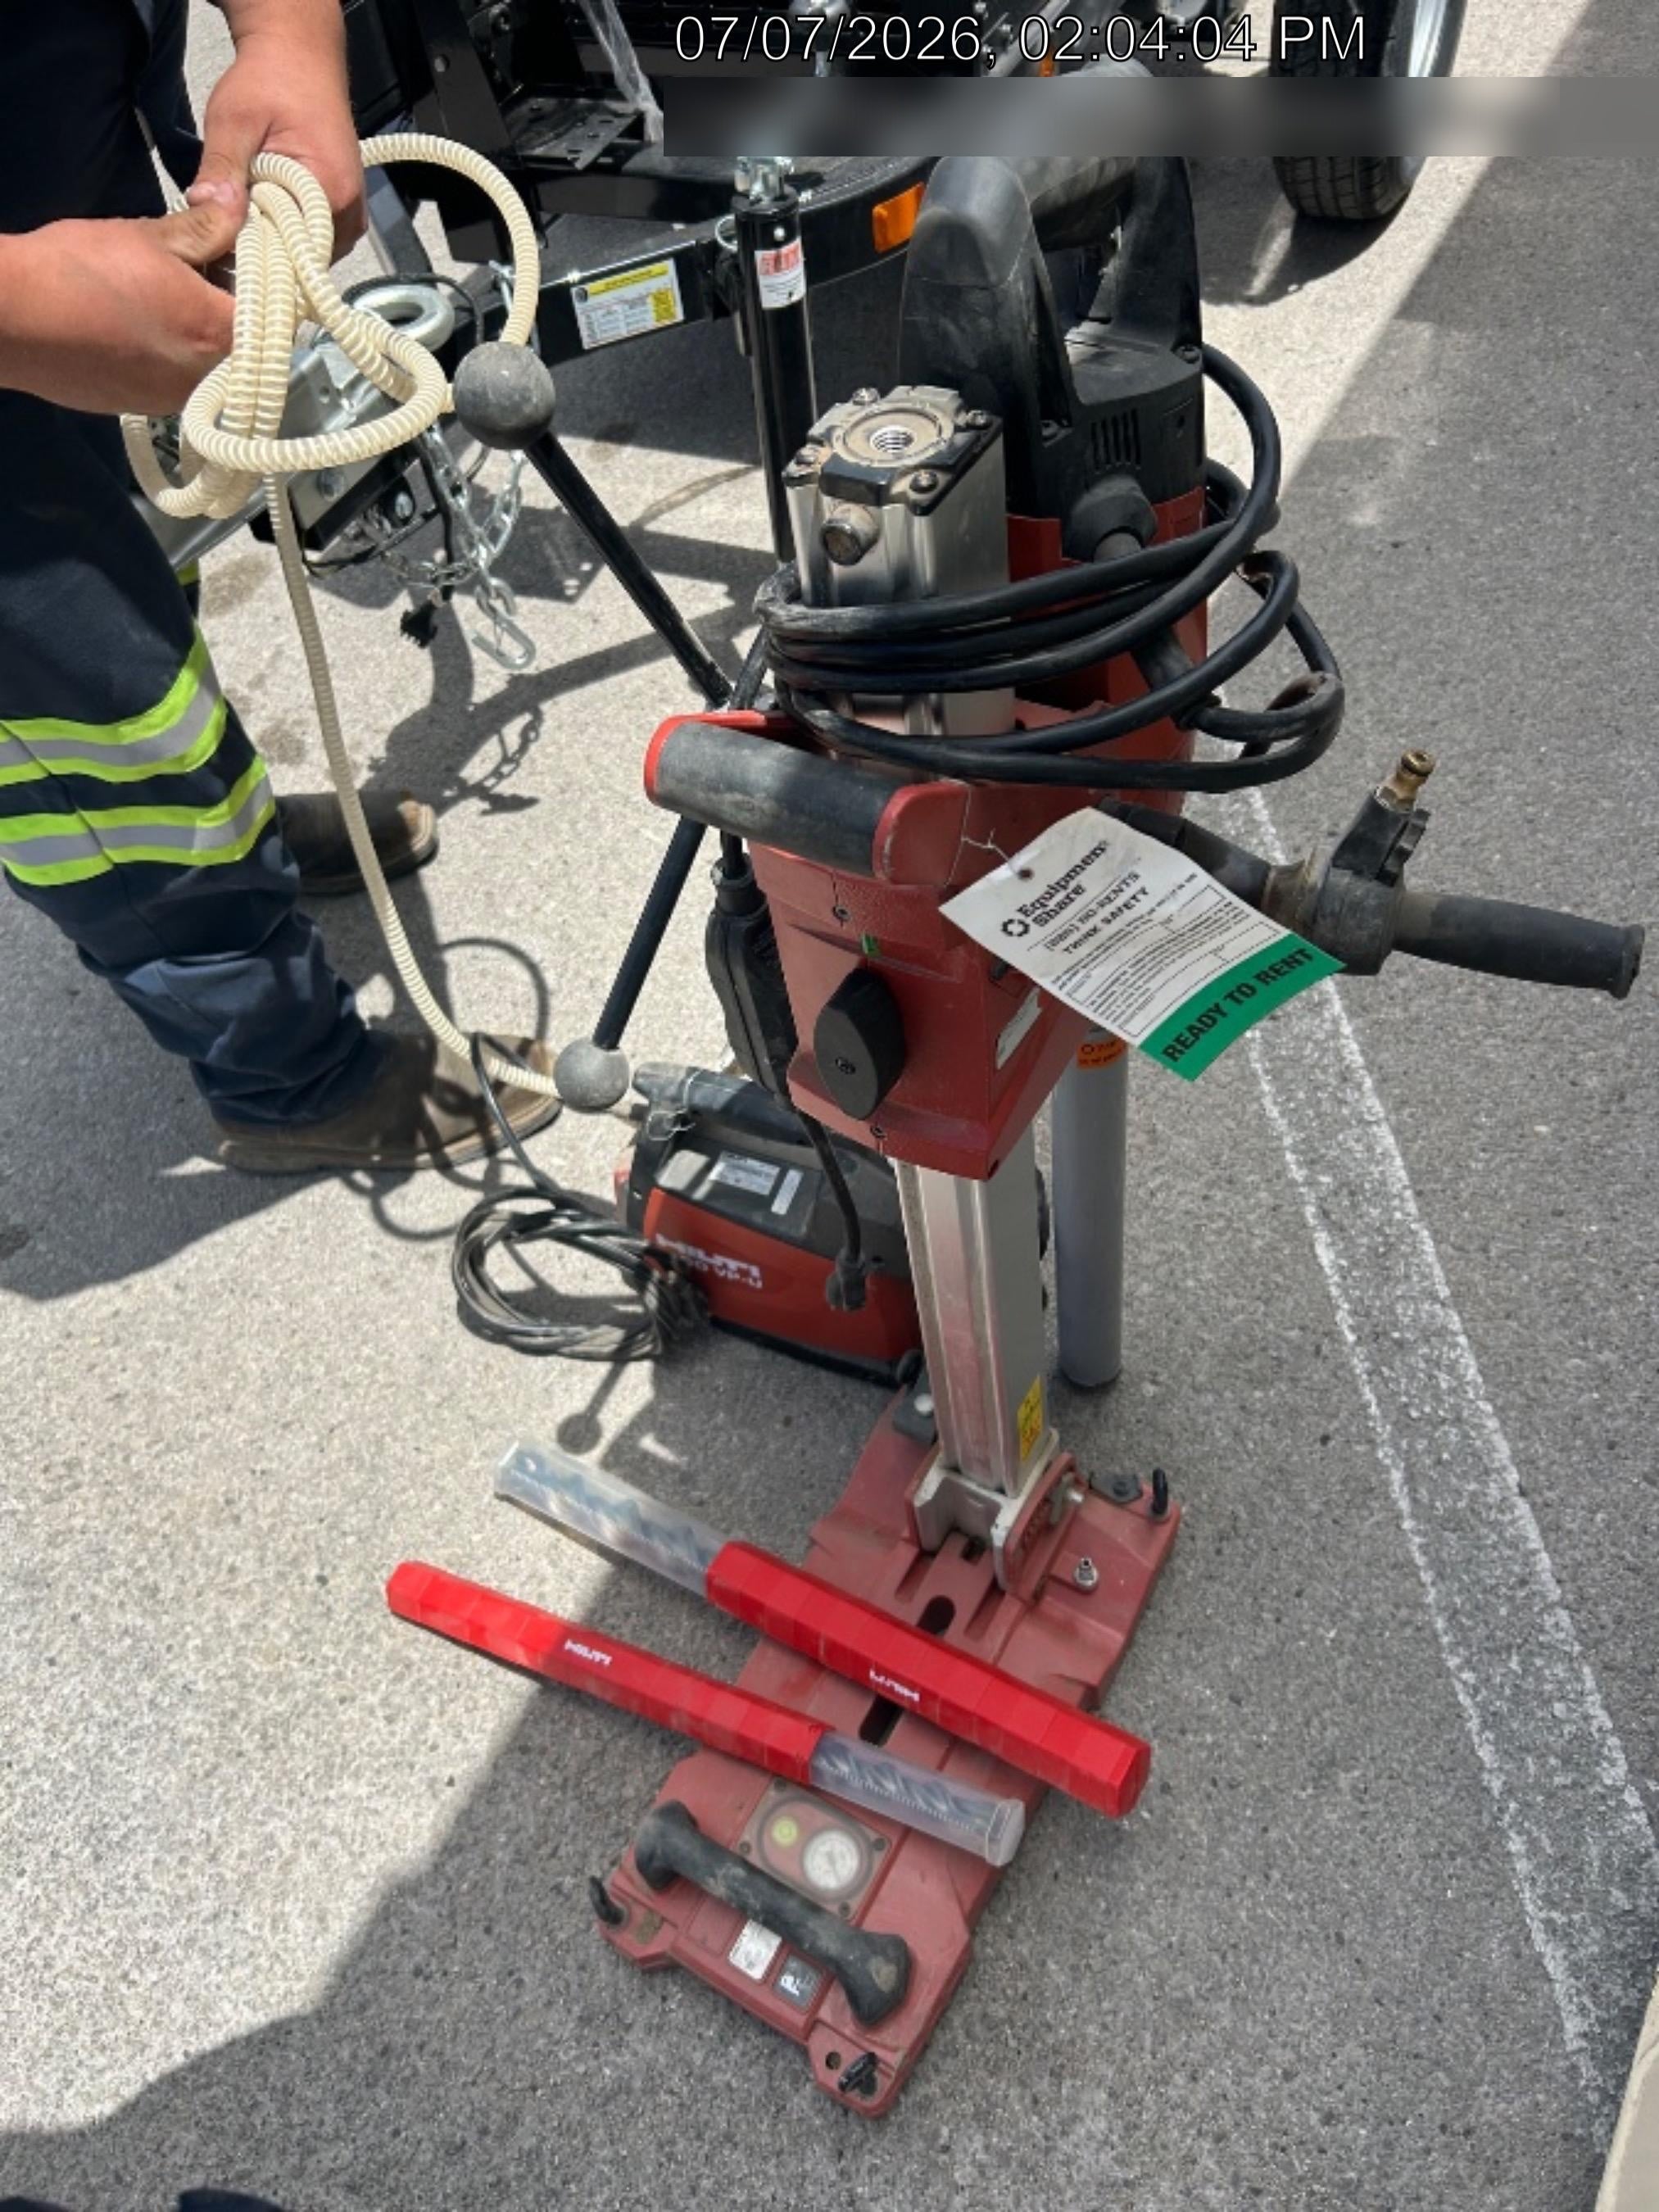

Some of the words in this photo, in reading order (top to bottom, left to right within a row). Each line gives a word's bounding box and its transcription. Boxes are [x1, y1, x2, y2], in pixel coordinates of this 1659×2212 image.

[1031, 883, 1087, 927] Share
[1099, 886, 1149, 925] SAFETY
[1162, 1002, 1228, 1063] READY
[1223, 982, 1258, 1006] TO
[1253, 947, 1314, 986] RENT
